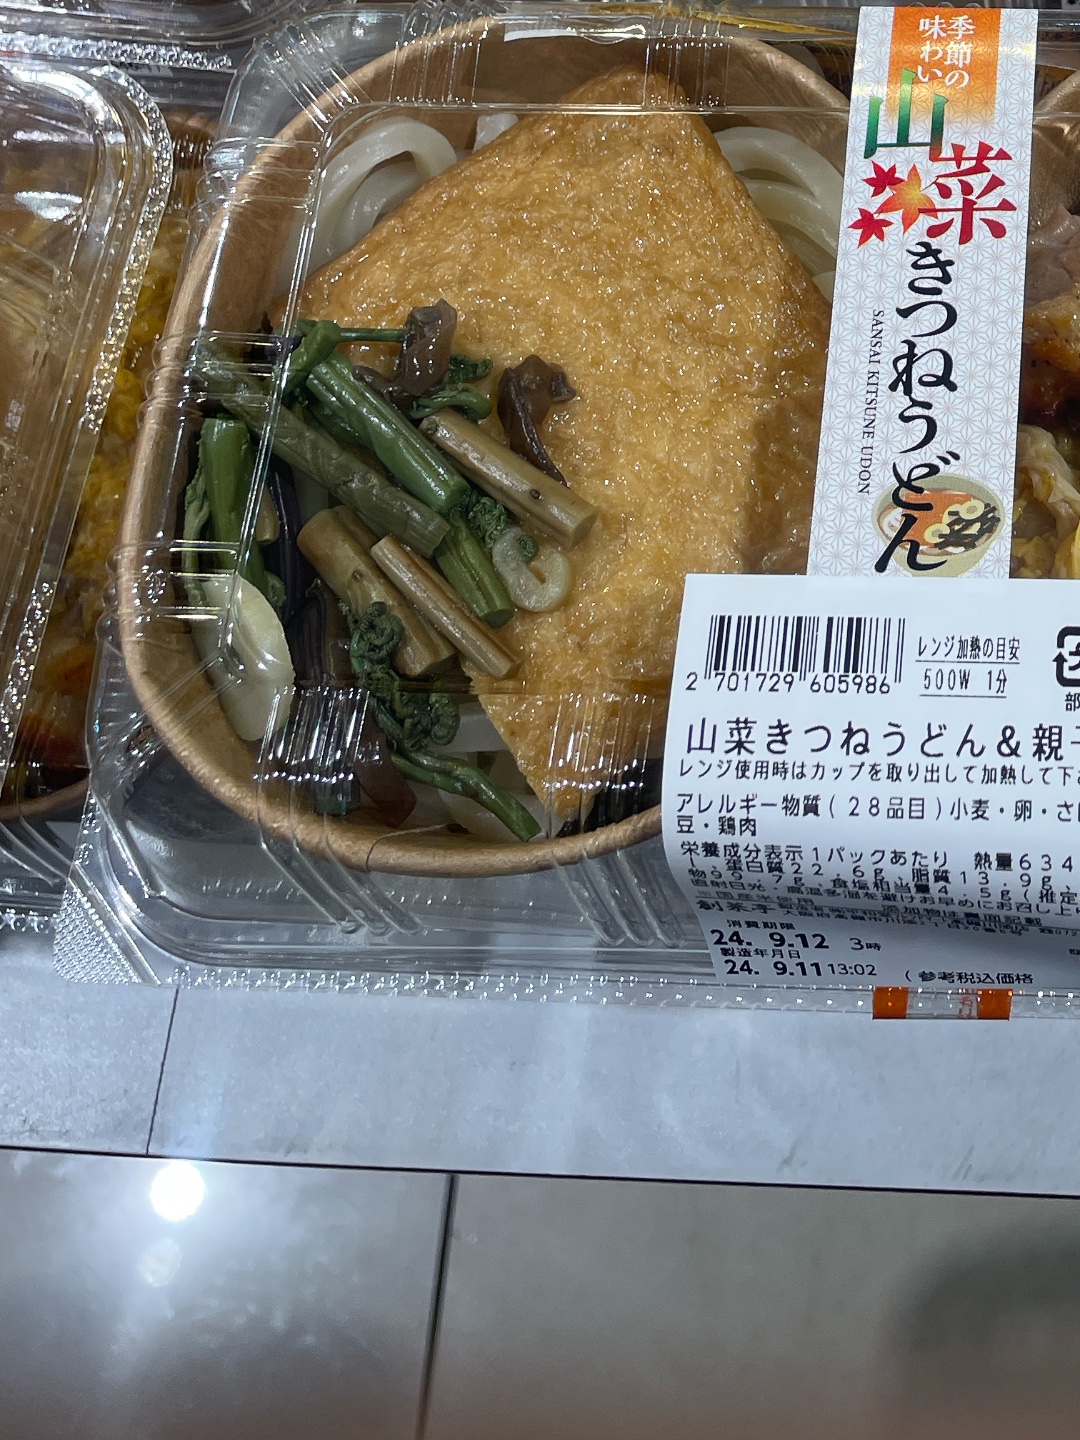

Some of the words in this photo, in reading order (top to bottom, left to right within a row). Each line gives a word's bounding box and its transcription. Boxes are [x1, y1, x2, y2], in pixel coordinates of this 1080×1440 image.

[917, 15, 946, 85] 味わい
[944, 15, 975, 91] 季節の
[863, 68, 1017, 245] 山菜
[870, 308, 885, 363] SANSAI
[862, 365, 880, 440] KITSUNE
[875, 241, 961, 574] きつねうどん
[857, 442, 873, 496] UDON
[917, 635, 1020, 661] レンジ加熱の目安
[685, 671, 698, 691] 2
[714, 672, 795, 693] 701729
[809, 674, 891, 694] 605986
[923, 668, 970, 691] 500W
[987, 668, 1007, 694] 1分
[676, 814, 757, 837] 豆・鶏肉
[720, 946, 801, 960] 製造年月日
[827, 962, 878, 977] 13:02
